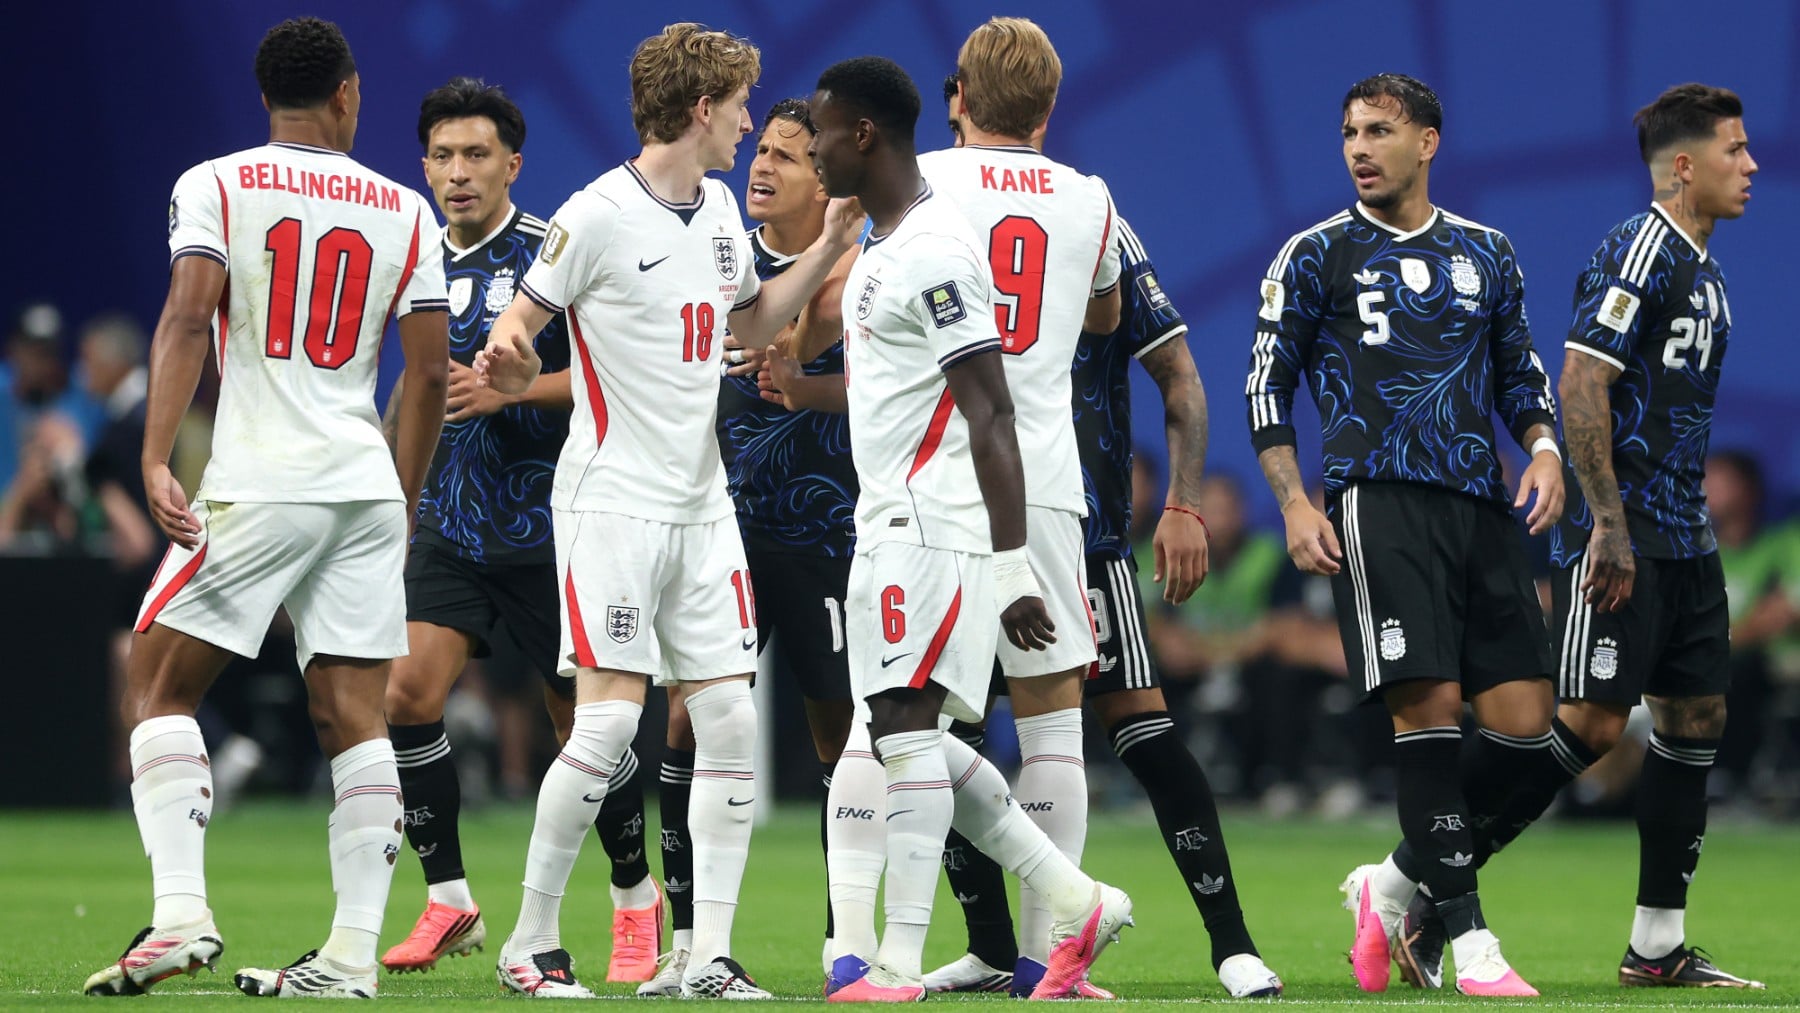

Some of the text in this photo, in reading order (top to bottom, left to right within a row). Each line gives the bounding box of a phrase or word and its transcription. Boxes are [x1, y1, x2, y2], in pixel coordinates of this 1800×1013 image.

[239, 163, 401, 212] BELLINGHAM
[980, 165, 1054, 194] KANE
[265, 217, 374, 370] 10
[988, 215, 1048, 356] 9
[680, 302, 714, 362] 18
[1357, 291, 1390, 346] 5
[1662, 317, 1713, 372] 24
[824, 597, 847, 653] 1
[881, 584, 906, 645] 6
[836, 806, 875, 821] ENG
[1020, 801, 1054, 813] ENG
